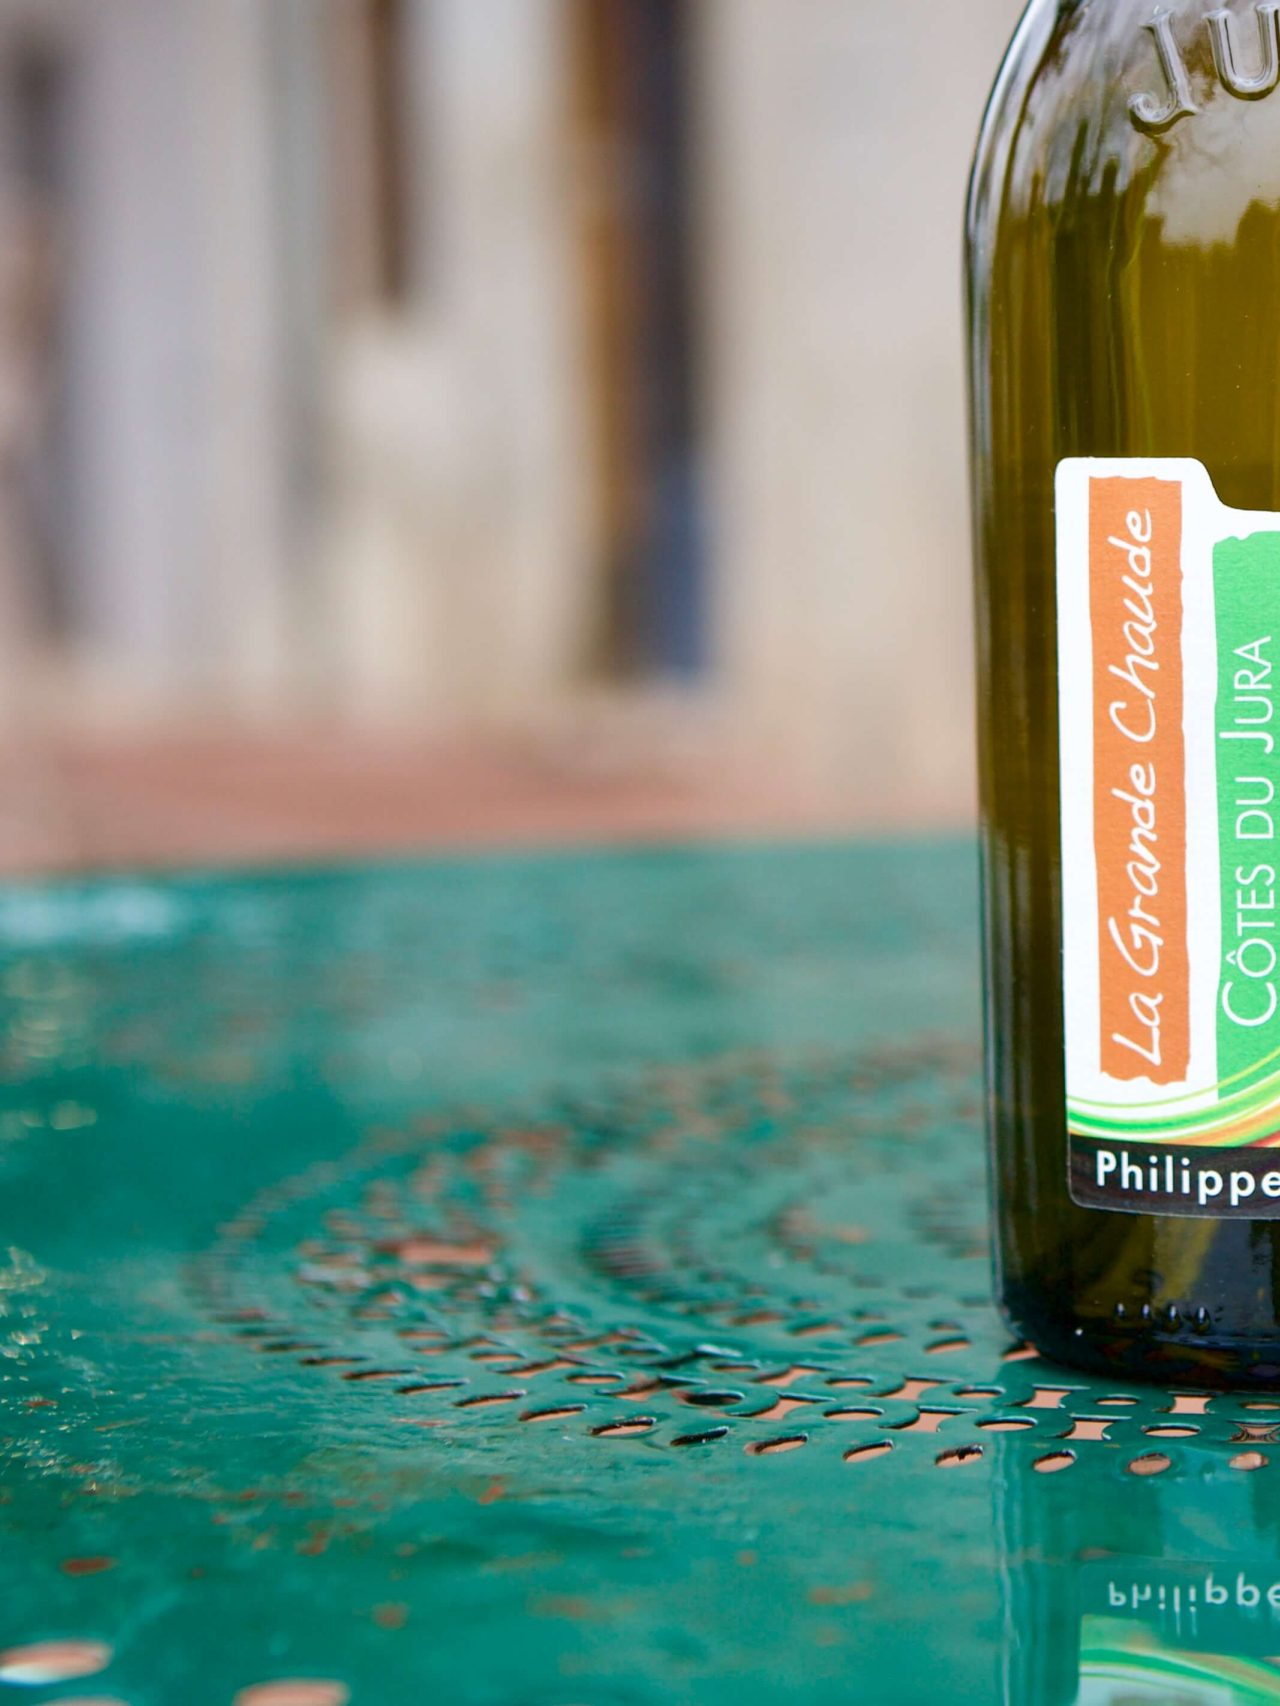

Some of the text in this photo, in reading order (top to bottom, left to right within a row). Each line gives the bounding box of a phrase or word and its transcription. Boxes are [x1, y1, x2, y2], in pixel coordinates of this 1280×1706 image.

[1107, 507, 1164, 1067] La Grande Chaude
[1219, 635, 1278, 1027] CÔTES DU JURA
